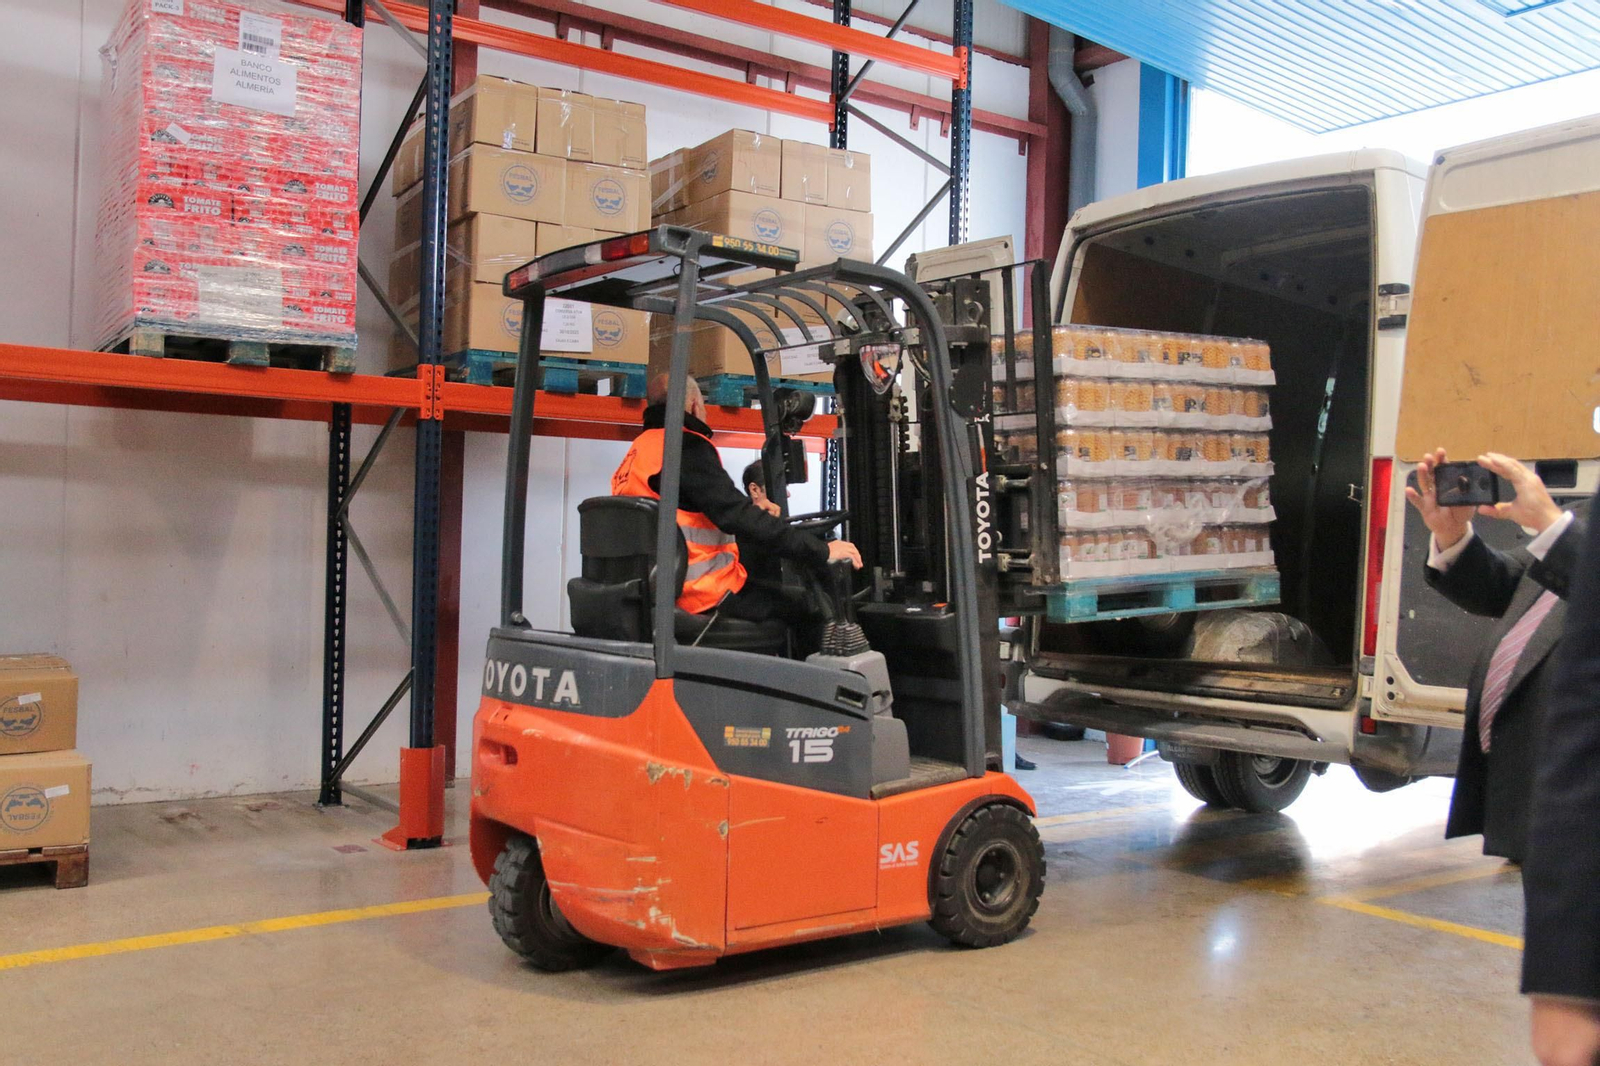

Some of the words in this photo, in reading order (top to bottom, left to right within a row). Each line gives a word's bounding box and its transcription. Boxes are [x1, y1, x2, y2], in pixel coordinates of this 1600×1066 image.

[240, 58, 273, 73] BANCO
[229, 67, 282, 86] ALIMENTOS
[315, 182, 349, 193] TOMATE
[183, 195, 222, 207] TOMATE
[315, 190, 349, 202] FRITO
[184, 204, 222, 217] FRITO
[314, 244, 348, 255] TOMATE
[723, 236, 741, 248] 950
[768, 245, 780, 256] 00
[314, 252, 348, 264] FRITO
[312, 305, 347, 316] TOMATE
[313, 313, 347, 324] FRITO
[597, 318, 620, 327] FESBAL
[975, 471, 993, 564] TOYOTA
[485, 658, 581, 706] OYOTA
[3, 706, 36, 714] FESBAL
[759, 738, 769, 747] 00
[788, 738, 834, 764] 15
[879, 840, 920, 864] SAS
